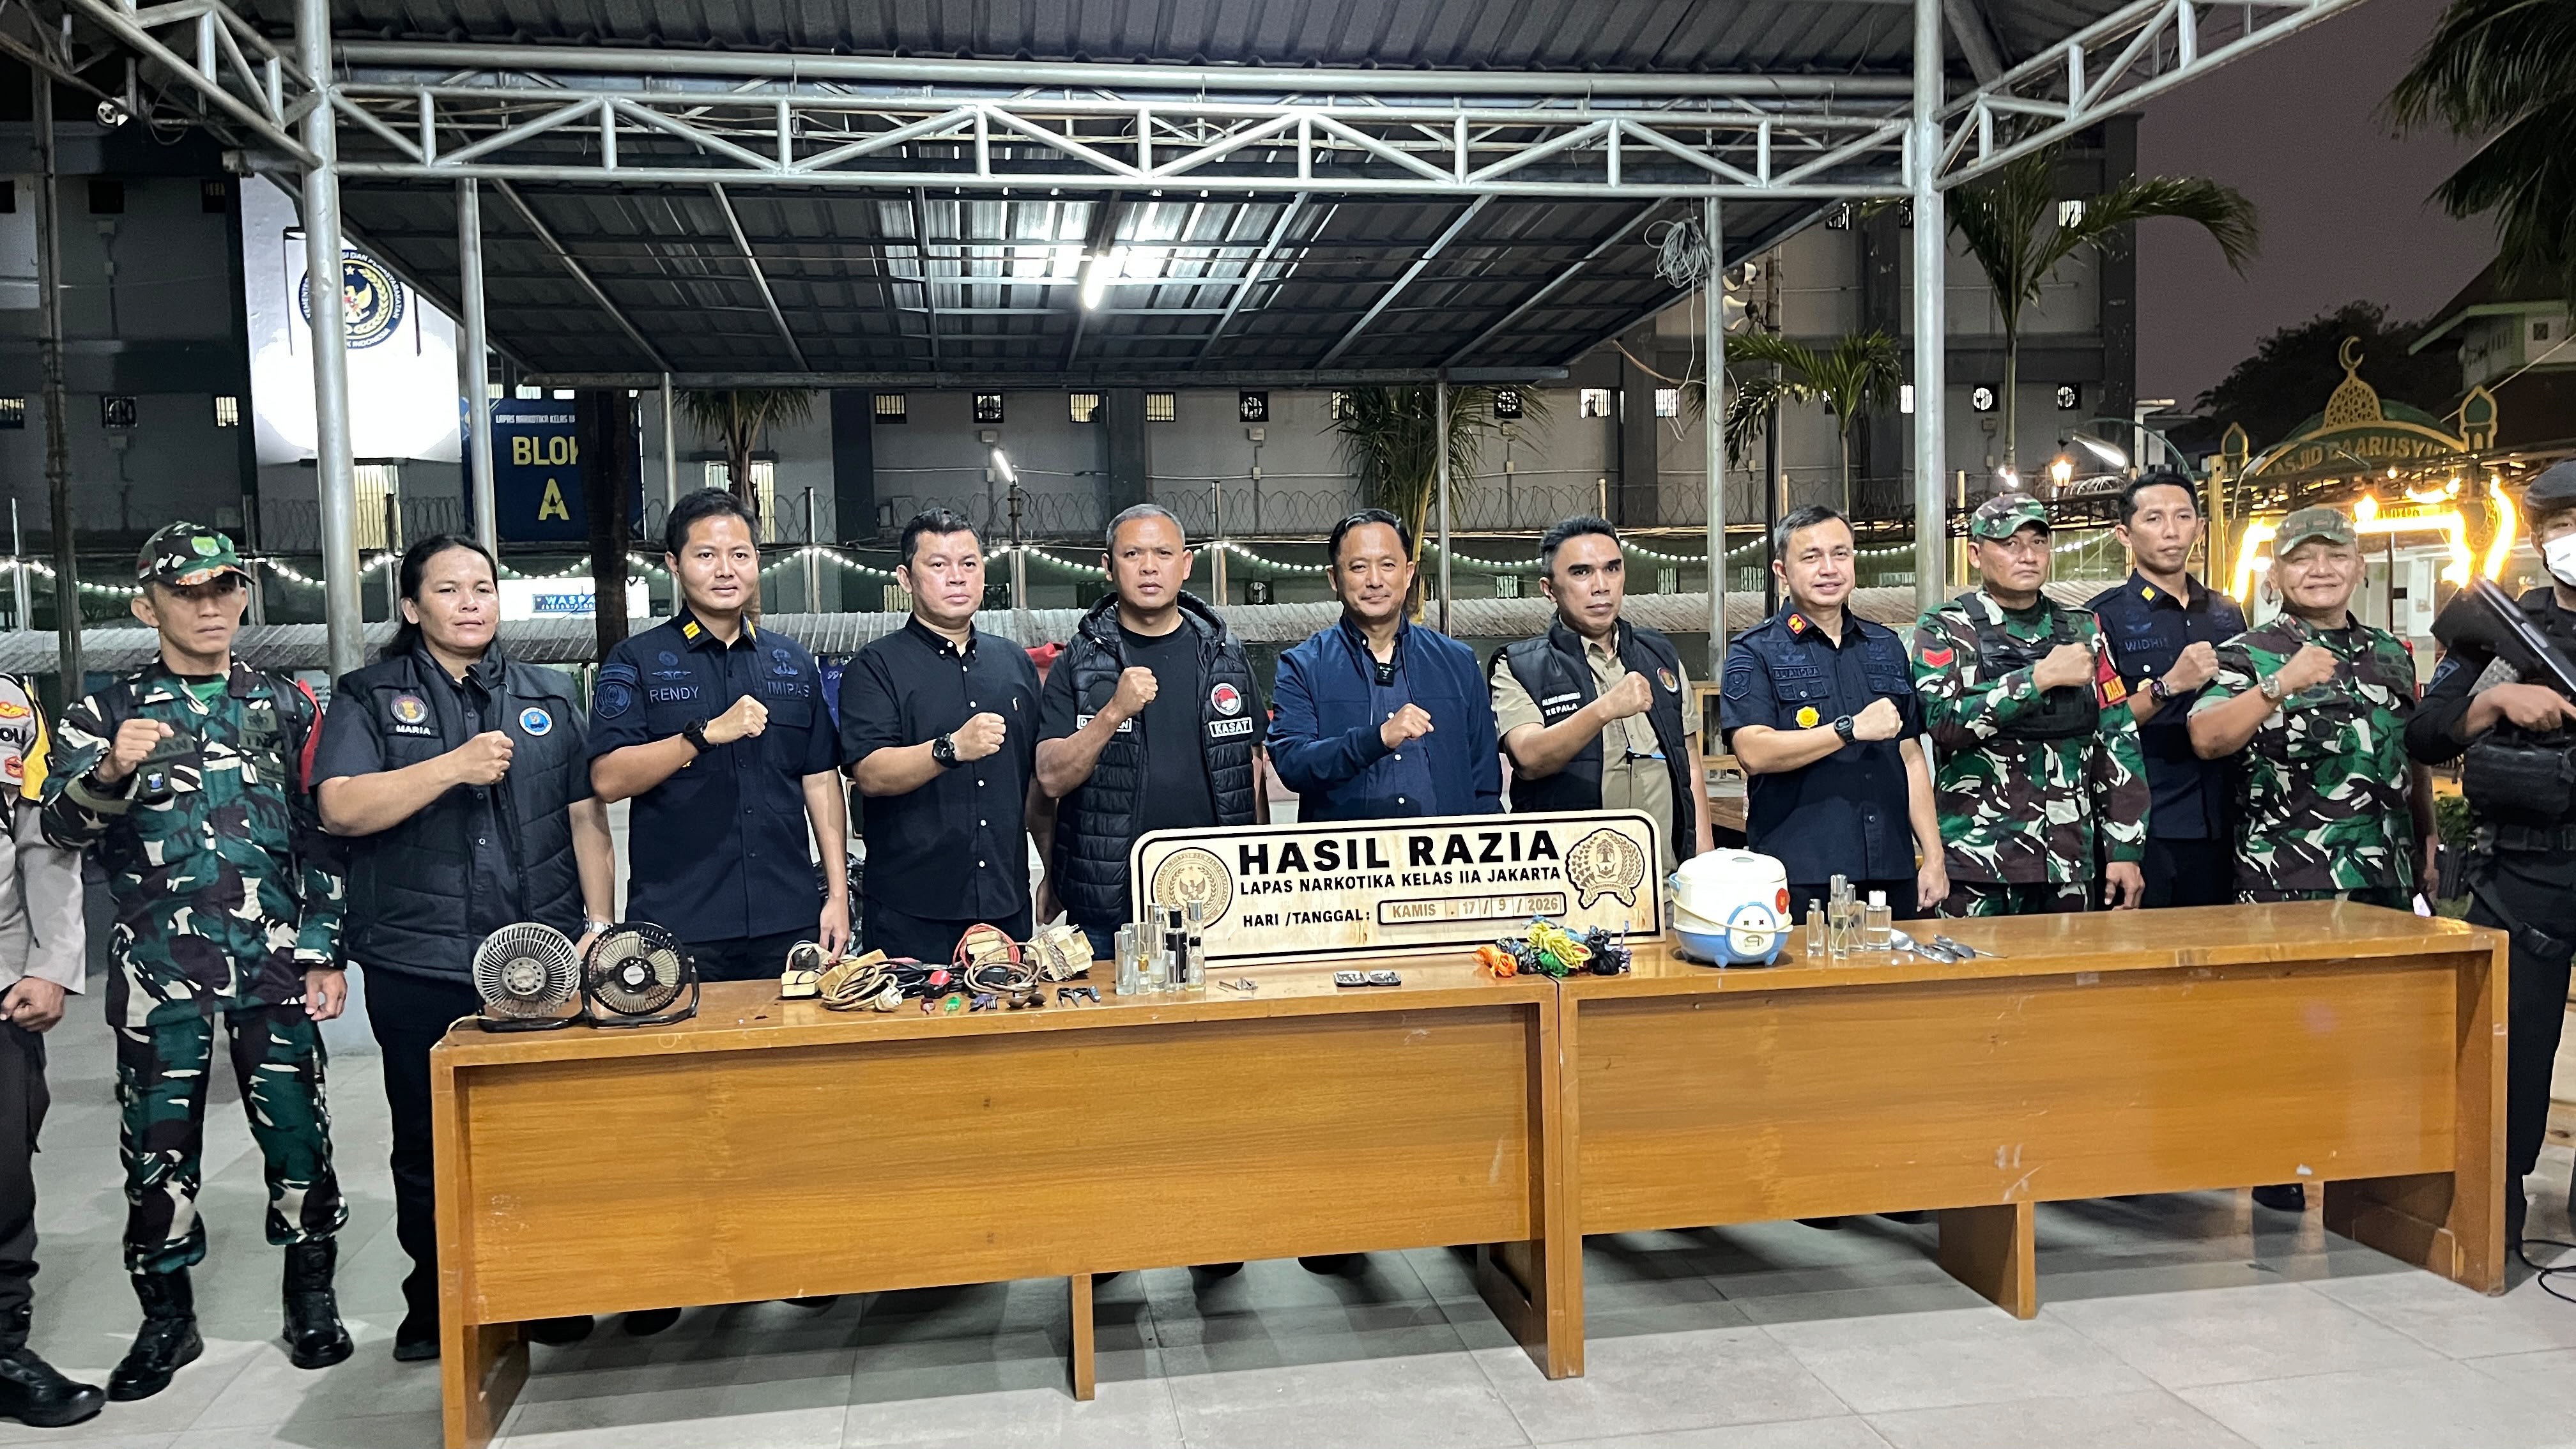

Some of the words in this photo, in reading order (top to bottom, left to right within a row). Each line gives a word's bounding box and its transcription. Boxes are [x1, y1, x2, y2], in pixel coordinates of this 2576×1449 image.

[538, 478, 570, 521] A
[544, 595, 595, 604] WASPA
[649, 686, 700, 703] RENDY
[767, 680, 811, 698] IMIPAS
[395, 724, 431, 735] MARIA
[1214, 720, 1249, 735] KASAT
[1239, 838, 1390, 876] HASIL
[1408, 830, 1560, 866] RAZIA
[1240, 880, 1293, 895] LAPAS
[1300, 874, 1395, 892] NARKOTIKA
[1401, 871, 1453, 887] KELAS
[1459, 870, 1482, 884] IIA
[1487, 866, 1561, 882] JAKARTA
[1243, 913, 1278, 927] HARI
[1392, 903, 1436, 918] KAMIS
